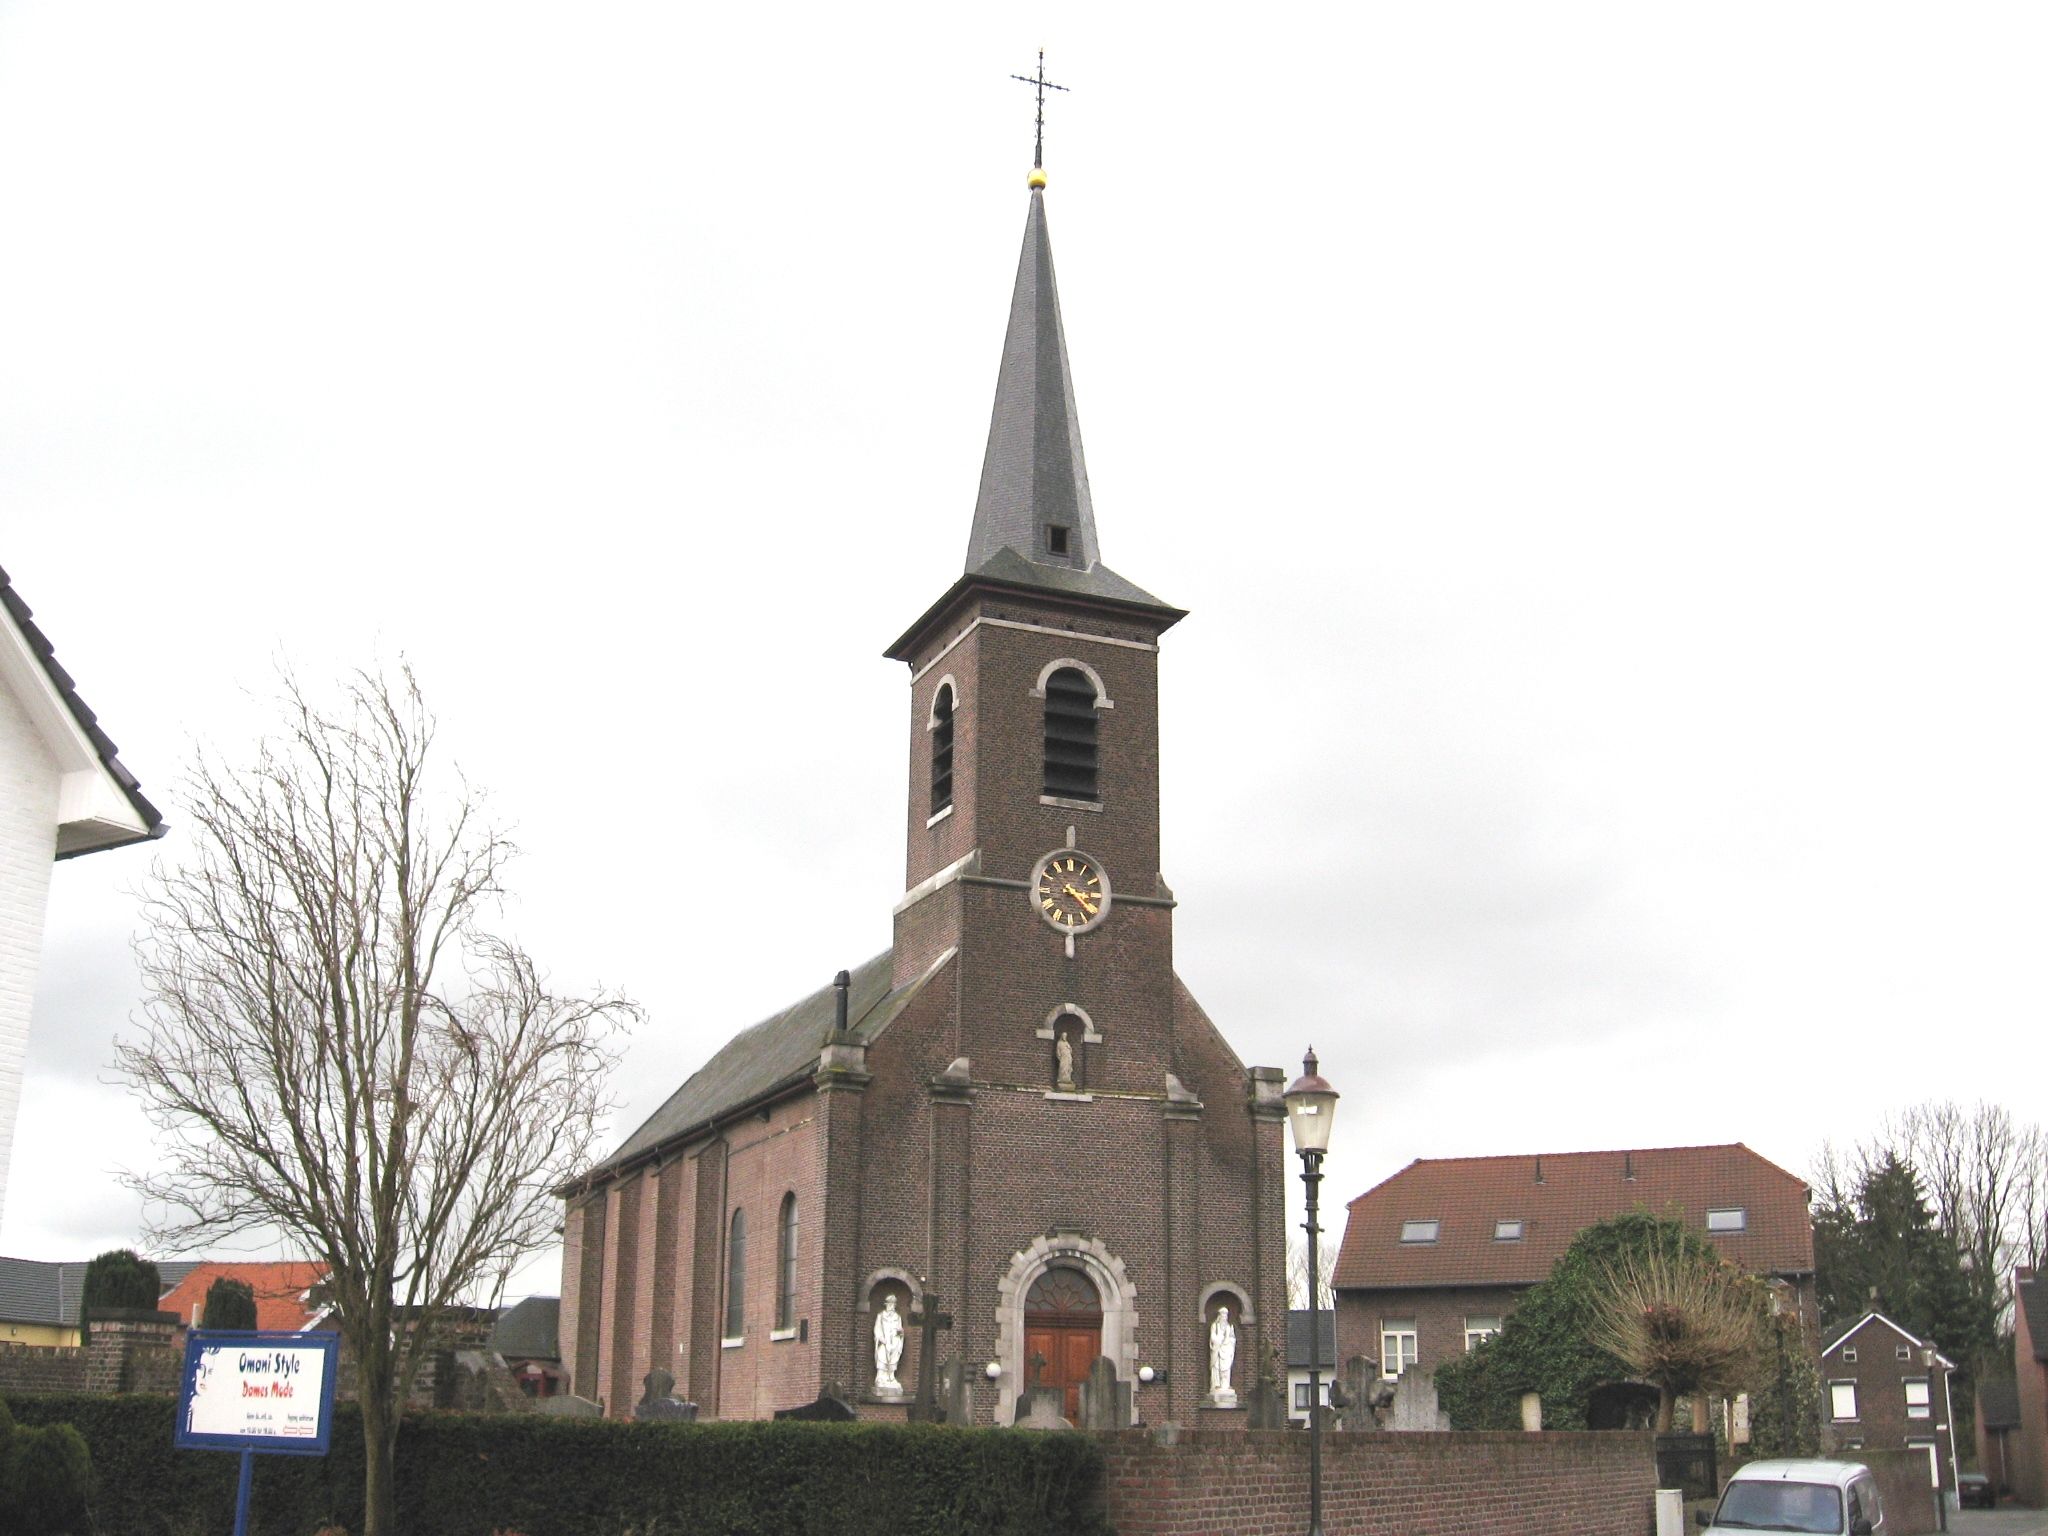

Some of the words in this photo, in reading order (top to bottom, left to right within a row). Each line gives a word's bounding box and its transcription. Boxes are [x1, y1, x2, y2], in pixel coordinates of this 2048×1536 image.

[239, 1352, 272, 1373] Omani
[274, 1352, 300, 1379] Style
[242, 1380, 268, 1398] Dames
[271, 1381, 294, 1399] Mode
